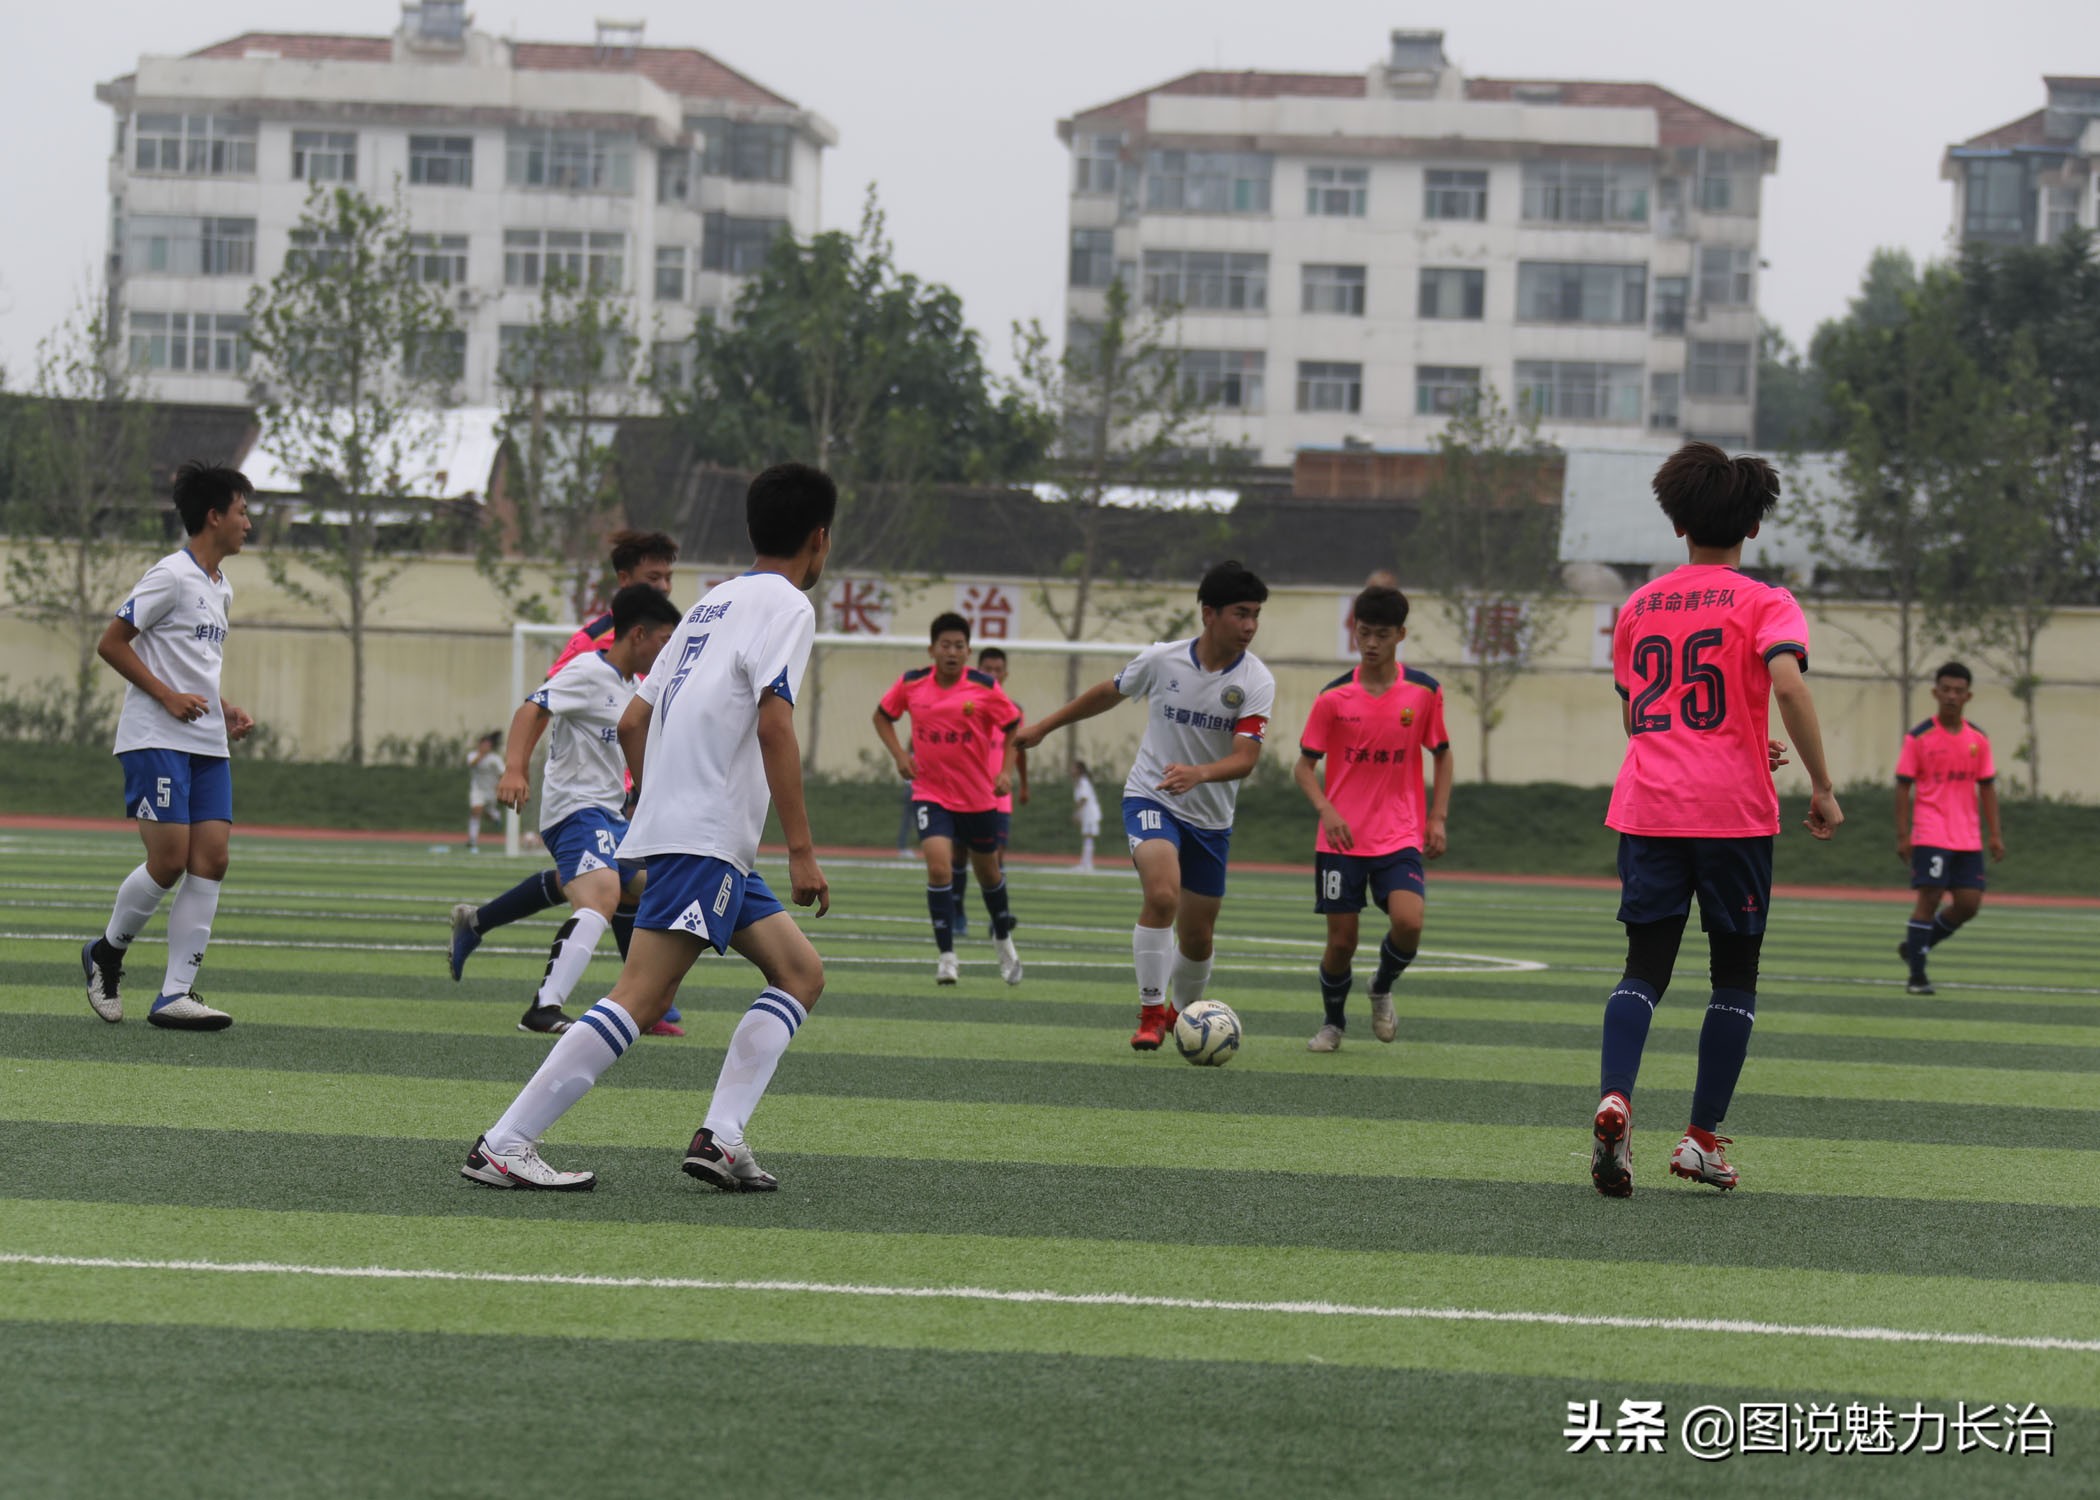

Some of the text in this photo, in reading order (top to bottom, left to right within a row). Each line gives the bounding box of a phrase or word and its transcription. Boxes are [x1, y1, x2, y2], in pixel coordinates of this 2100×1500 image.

[1631, 628, 1727, 736] 25
[156, 776, 172, 808] 5
[917, 806, 929, 830] 5
[1137, 809, 1162, 831] 10
[1929, 856, 1943, 878] 3
[713, 873, 733, 917] 6
[1322, 868, 1341, 900] 18
[1708, 1003, 1747, 1015] KELME
